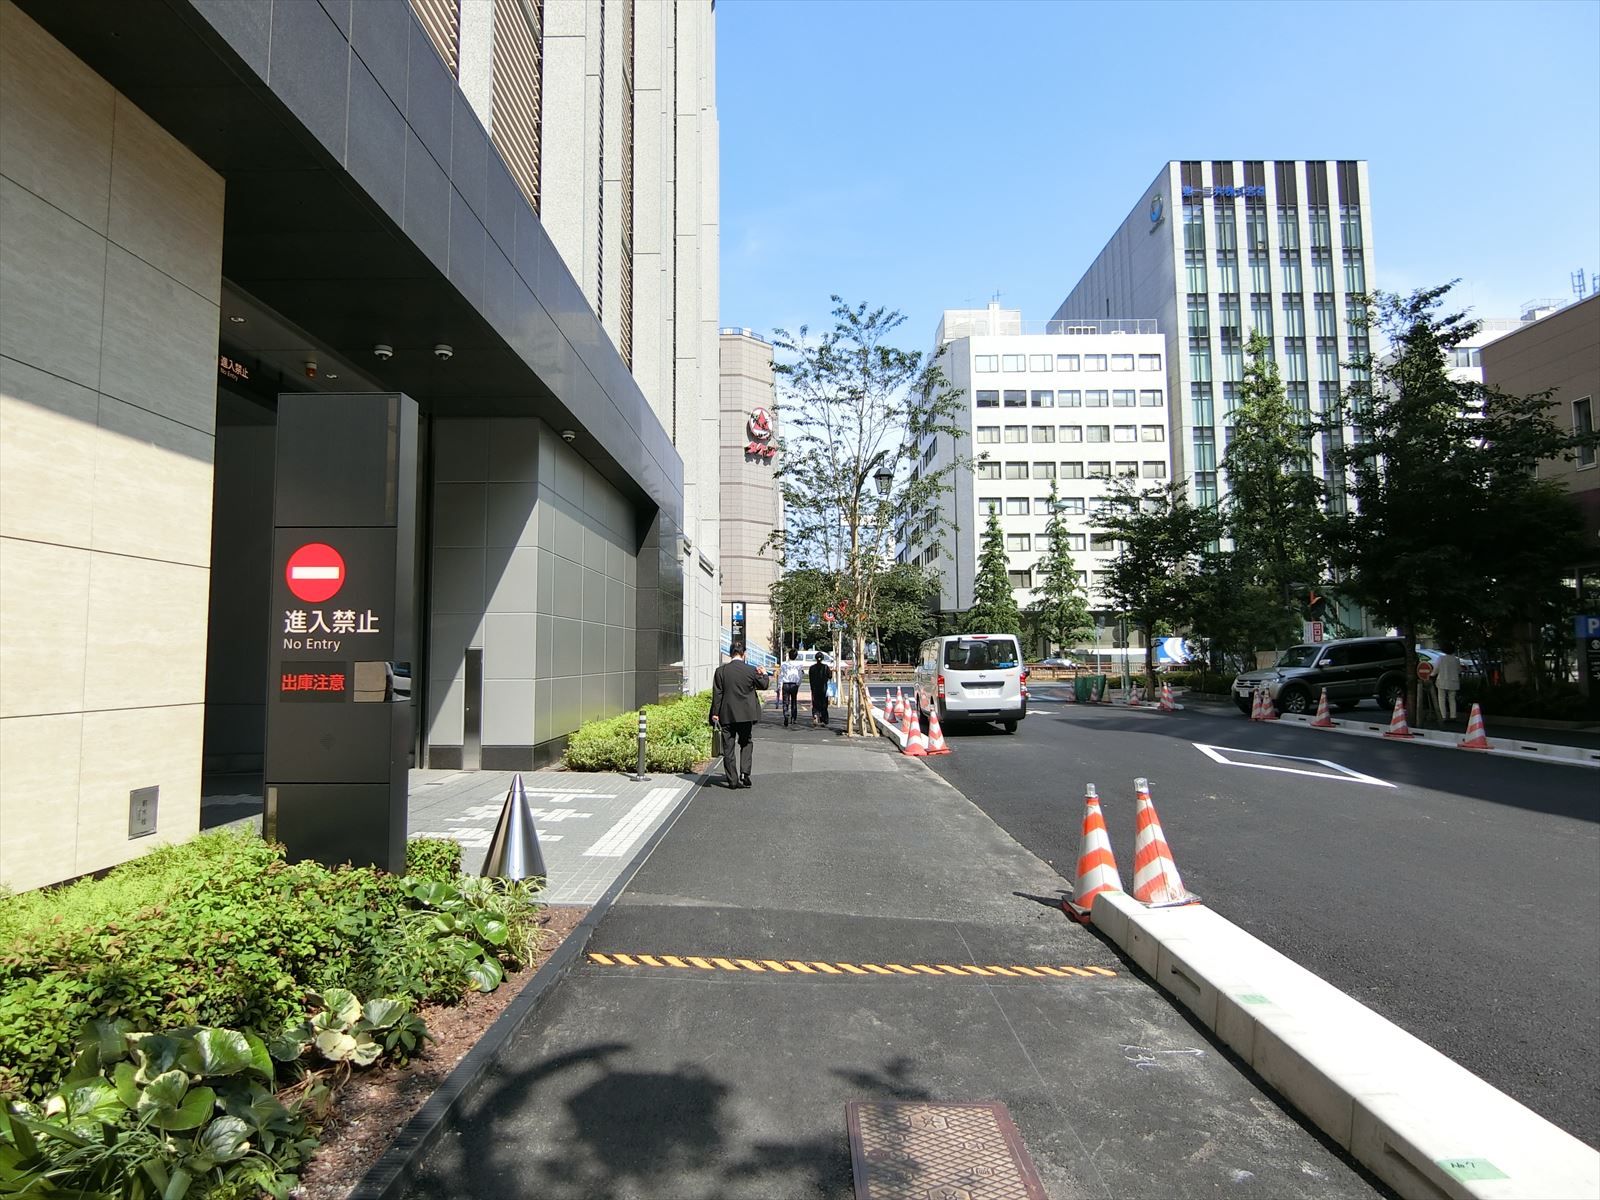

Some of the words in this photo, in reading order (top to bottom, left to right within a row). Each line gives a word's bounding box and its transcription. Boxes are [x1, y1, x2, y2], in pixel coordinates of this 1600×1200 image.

[284, 609, 380, 634] 進入禁止
[283, 638, 302, 650] No
[306, 638, 341, 652] Entry
[281, 674, 345, 691] 出庫注意
